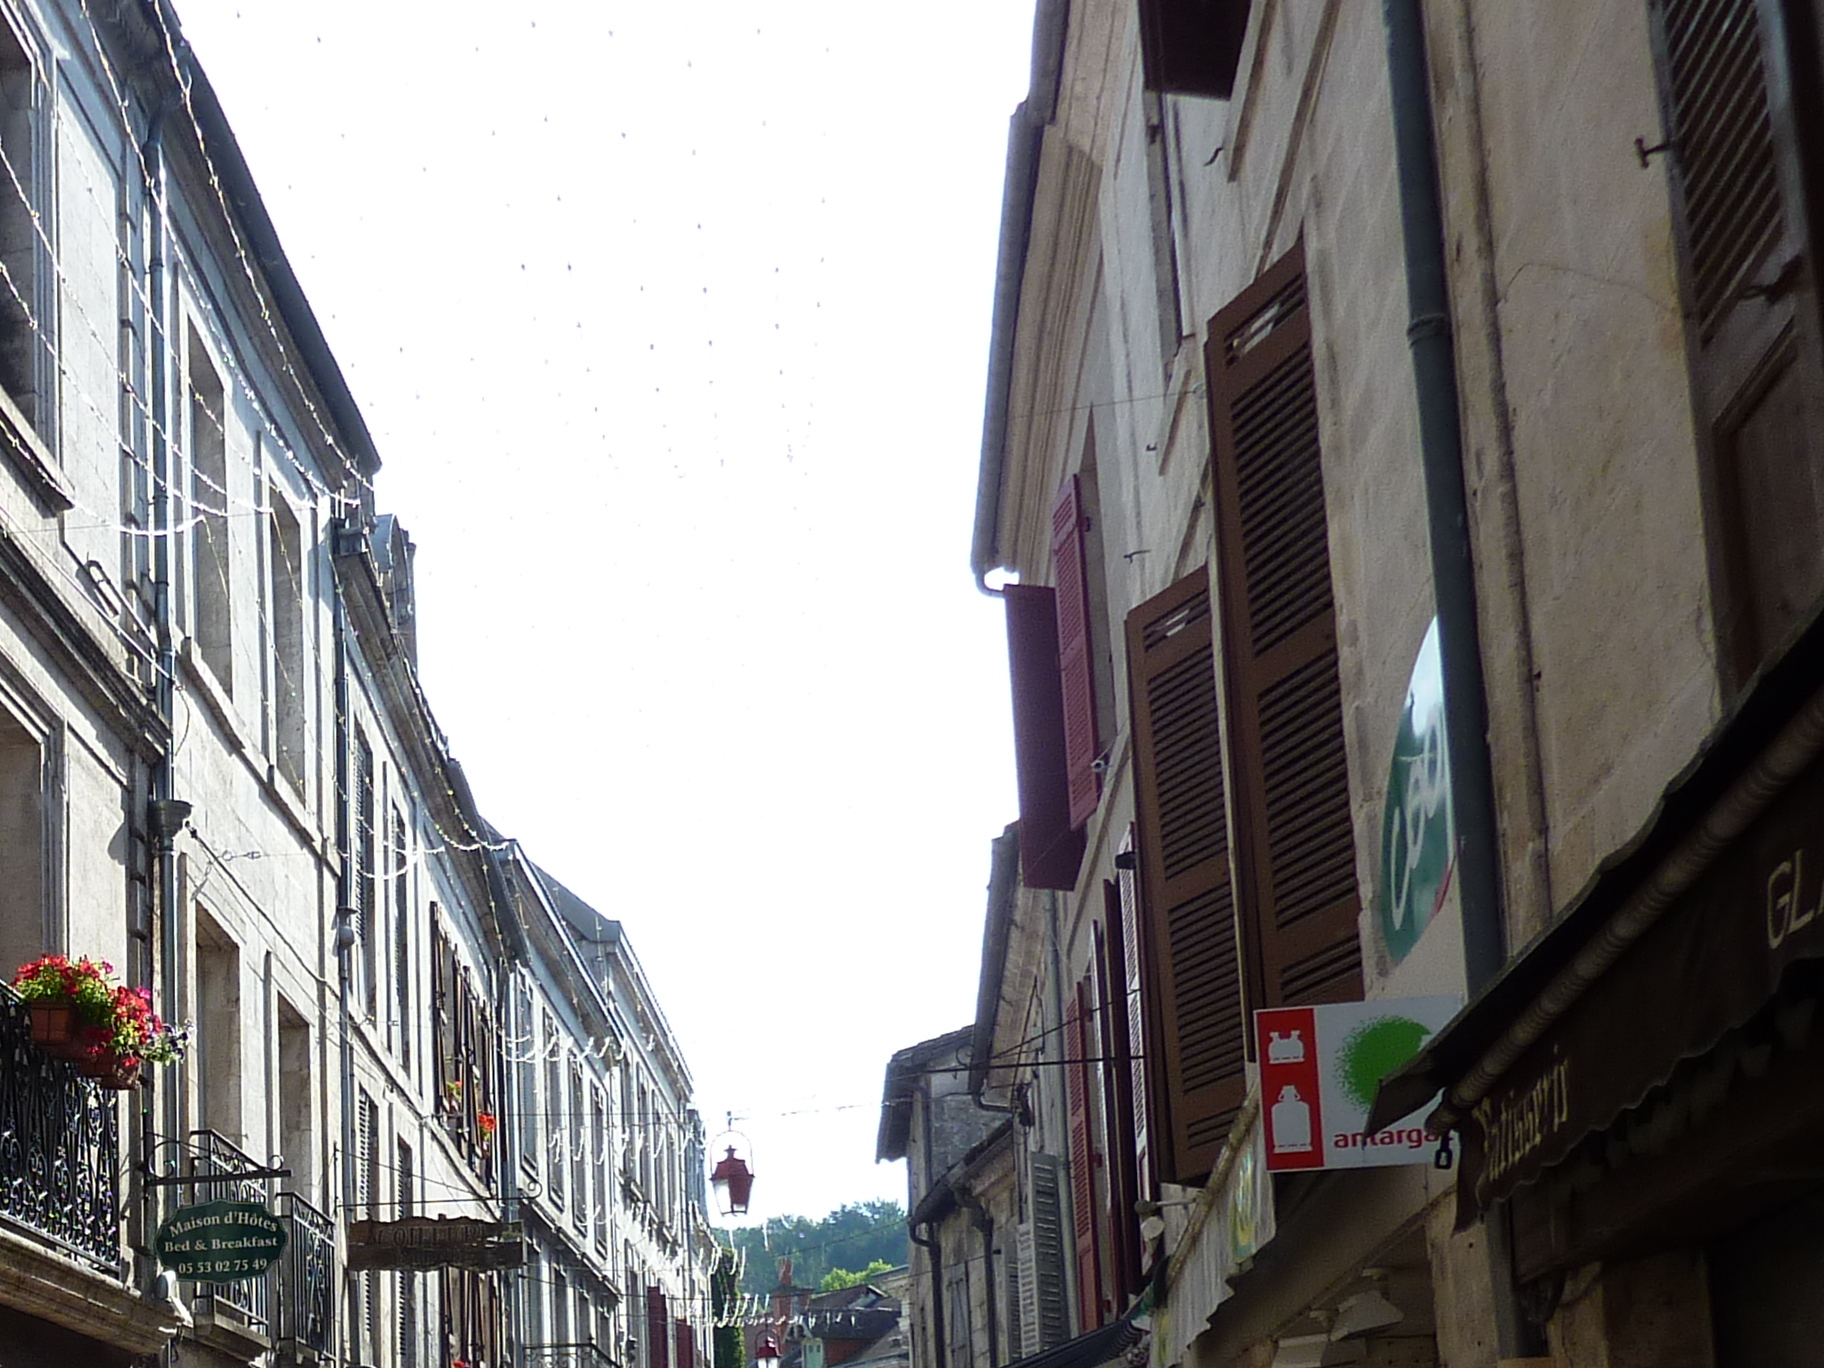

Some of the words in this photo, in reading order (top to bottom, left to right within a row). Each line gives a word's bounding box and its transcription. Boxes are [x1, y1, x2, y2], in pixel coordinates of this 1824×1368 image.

[1766, 848, 1824, 950] GL
[168, 1214, 220, 1239] Maison
[224, 1211, 278, 1233] d'Hôtes
[164, 1240, 190, 1253] Bed
[194, 1240, 208, 1252] &
[211, 1236, 278, 1250] Breakfast
[178, 1262, 193, 1274] 05
[197, 1261, 212, 1274] 53
[215, 1260, 230, 1273] 02
[233, 1259, 249, 1272] 75
[252, 1258, 268, 1271] 49
